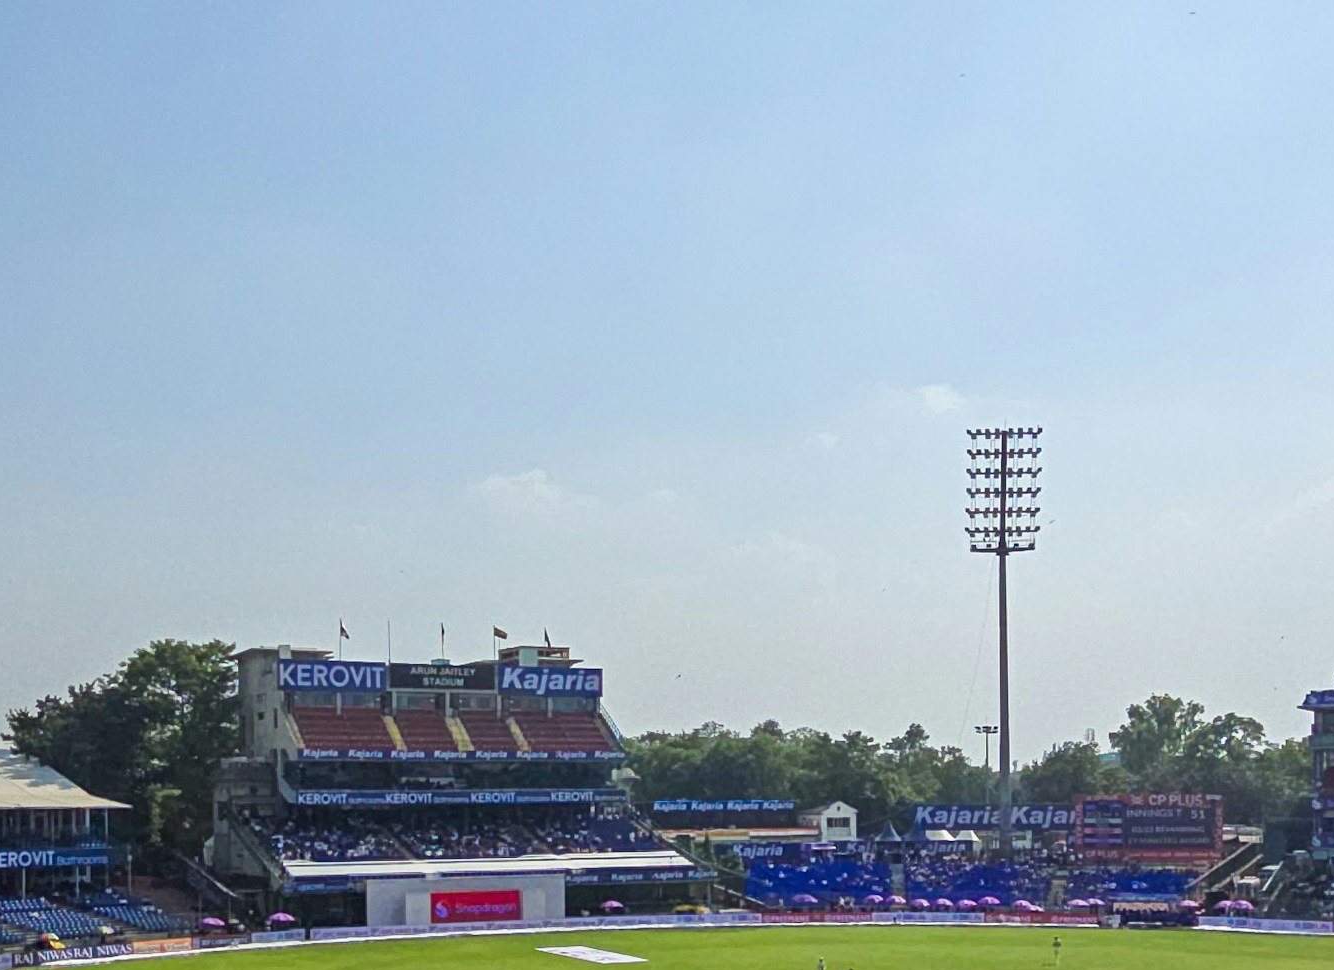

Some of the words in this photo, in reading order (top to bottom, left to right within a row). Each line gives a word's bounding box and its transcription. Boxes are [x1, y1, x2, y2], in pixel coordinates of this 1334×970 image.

[279, 663, 385, 689] KEROVIT
[410, 666, 437, 676] ARUN
[438, 667, 476, 677] JAITLEY
[422, 677, 465, 687] STADIUM
[501, 667, 601, 695] Kajaria
[303, 749, 339, 759] Kajaria
[390, 750, 425, 760] Kajaria
[434, 750, 467, 760] Kajaria
[475, 750, 508, 760] Kajaria
[297, 793, 348, 805] KEROVIT
[385, 792, 433, 805] KEROVIT
[470, 792, 516, 804] KEROVIT
[551, 791, 594, 803] KEROVIT
[1148, 794, 1167, 806] CP
[1168, 794, 1204, 807] PLUS
[654, 800, 687, 812] Kajaria
[727, 799, 760, 812] Kajaria
[915, 805, 1002, 829] Kajaria
[732, 842, 784, 861] Kajaria
[56, 854, 109, 866] Bathrooms
[454, 900, 518, 915] Snapdragon
[14, 952, 34, 965] RAJ
[38, 949, 73, 963] NIWAS
[73, 946, 93, 959] RAJ
[97, 944, 133, 957] NIWAS
